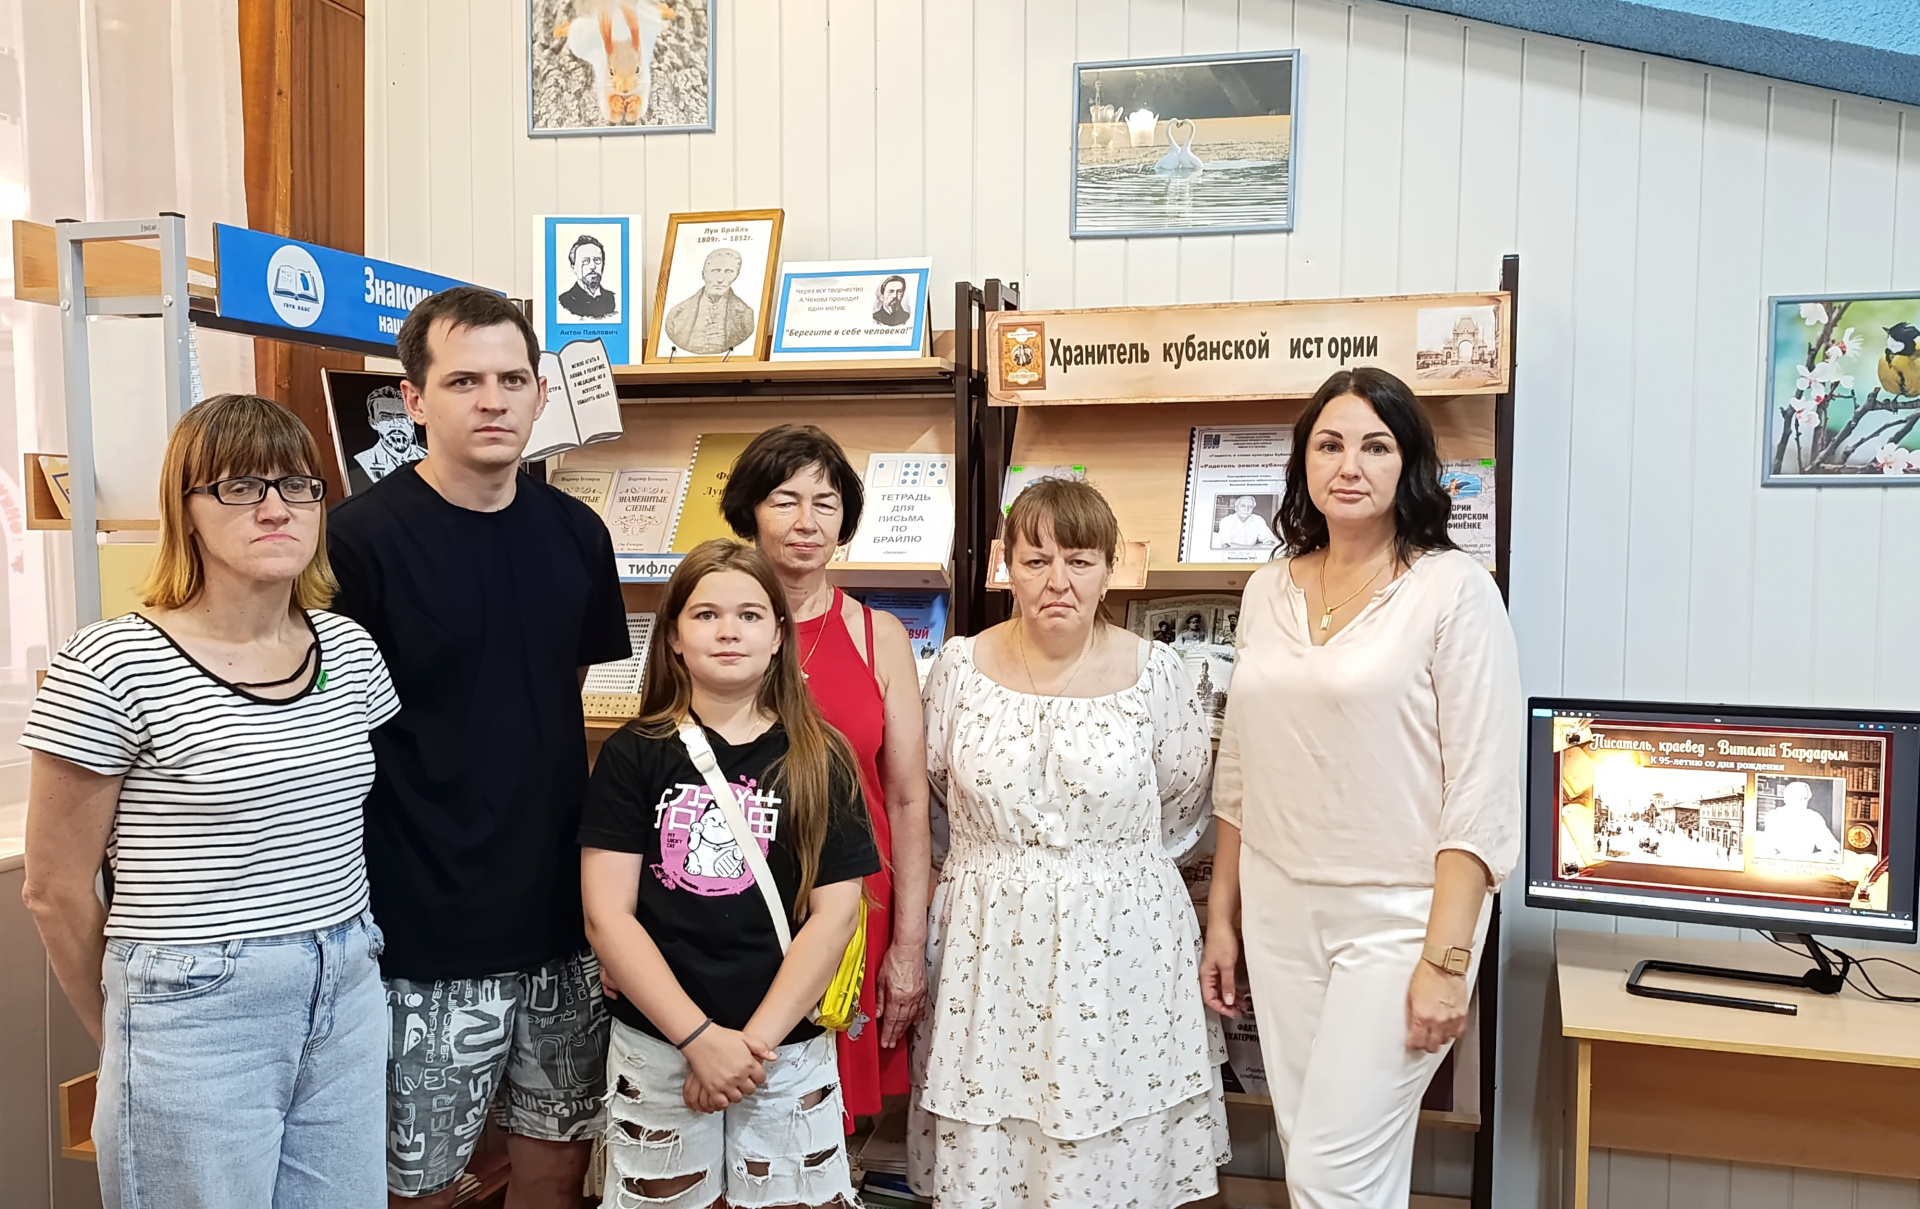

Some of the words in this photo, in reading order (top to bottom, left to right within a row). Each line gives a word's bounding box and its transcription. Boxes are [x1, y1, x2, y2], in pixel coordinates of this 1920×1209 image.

[721, 226, 749, 234] Брайль
[364, 266, 433, 312] Знаком
[378, 315, 406, 335] наш
[785, 328, 832, 338] "Берегите
[841, 328, 861, 336] себе
[863, 326, 914, 336] человека!"
[1049, 337, 1150, 373] Хранитель
[1162, 331, 1270, 370] кубанской
[881, 494, 931, 502] ТЕТРАДЬ
[625, 504, 656, 512] СЛЕПЫЕ
[891, 504, 915, 512] ДЛЯ
[873, 534, 922, 543] БРАЙЛЮ
[1589, 733, 1656, 752] Писатель,
[1658, 740, 1705, 757] краевед
[1717, 739, 1776, 758] Виталий
[1779, 742, 1849, 763] Бардадым
[1650, 756, 1657, 764] К
[1659, 757, 1703, 767] 95-летию
[1704, 759, 1716, 768] со
[1717, 760, 1735, 770] дня
[1737, 761, 1785, 772] рождения
[1237, 1023, 1258, 1032] ФАКТ
